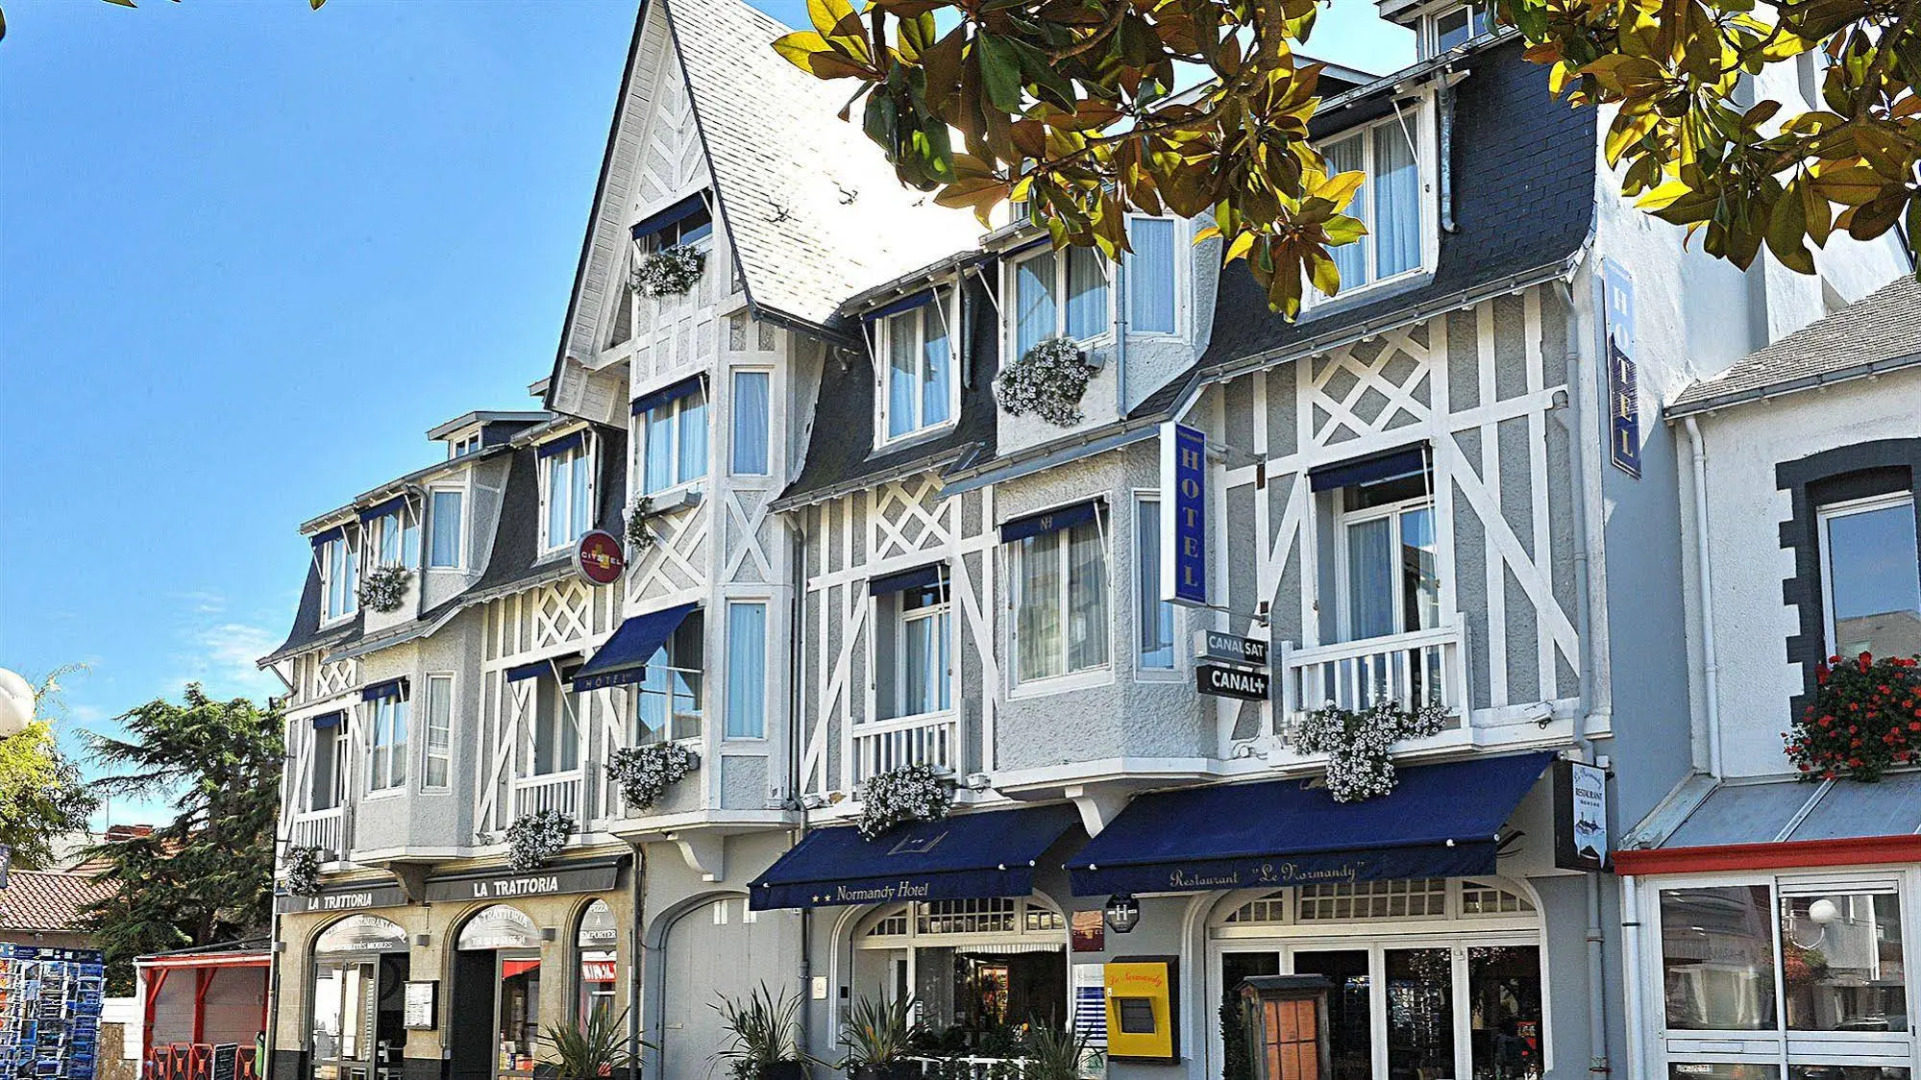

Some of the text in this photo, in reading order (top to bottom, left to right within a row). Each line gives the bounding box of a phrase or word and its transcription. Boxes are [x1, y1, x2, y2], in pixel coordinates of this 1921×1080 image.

[1612, 286, 1634, 459] HOTEL
[1181, 447, 1199, 588] HOTEL
[1211, 669, 1266, 694] CANAL+
[474, 876, 558, 897] LA TRATTORIA
[1169, 869, 1239, 887] Restaurant
[307, 892, 373, 910] LA TRATTORIA
[837, 880, 929, 902] Normandy Hotel
